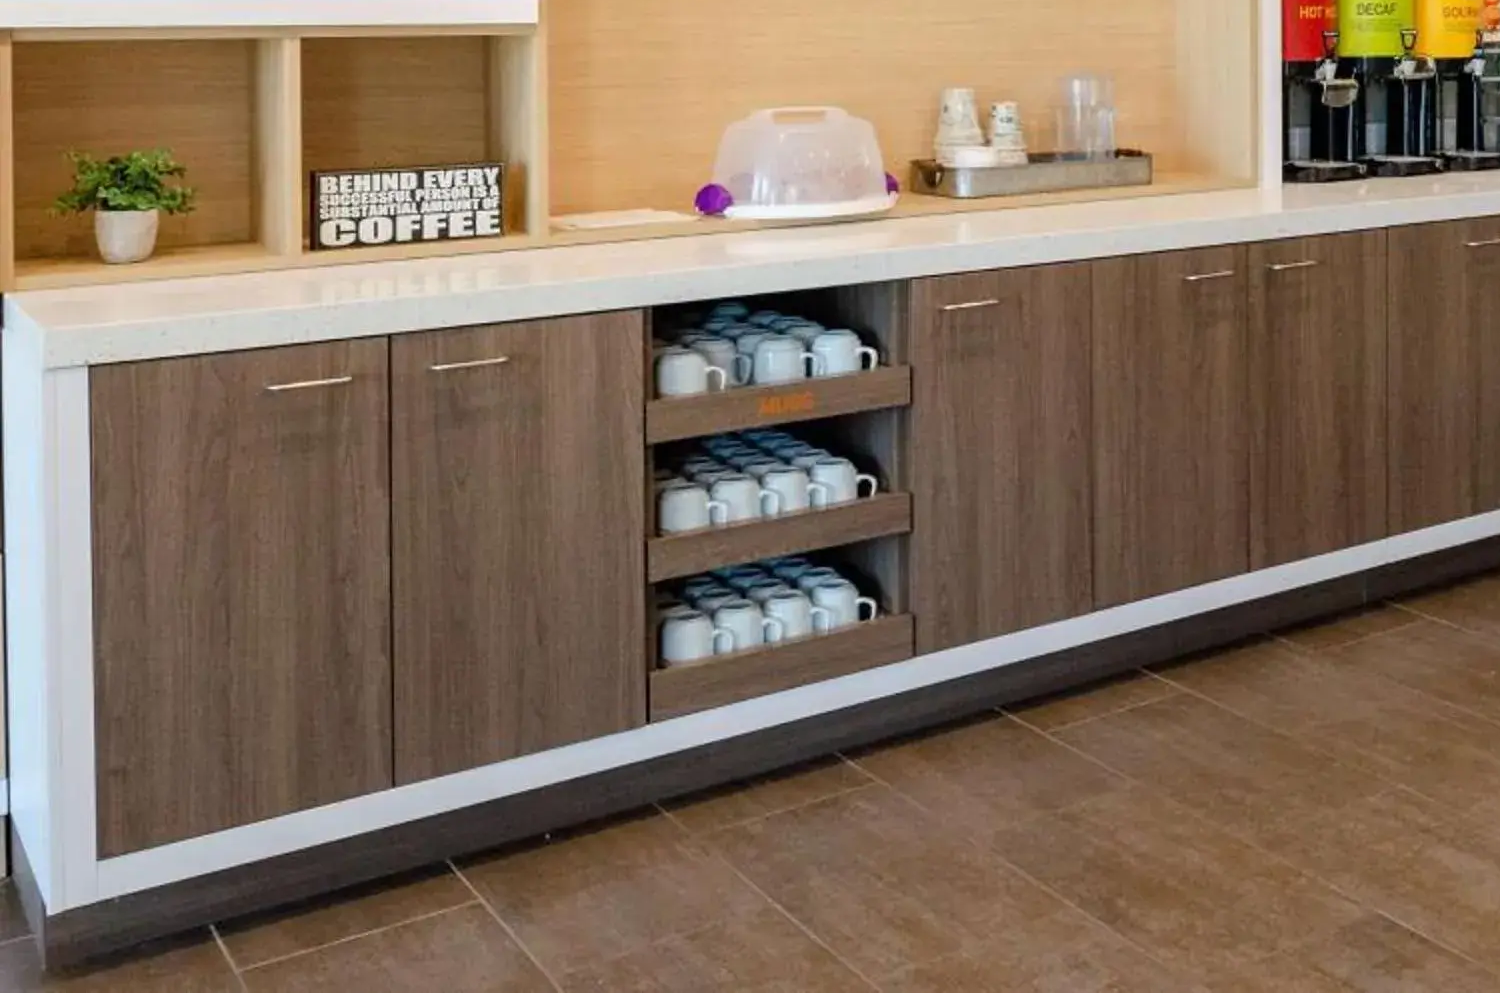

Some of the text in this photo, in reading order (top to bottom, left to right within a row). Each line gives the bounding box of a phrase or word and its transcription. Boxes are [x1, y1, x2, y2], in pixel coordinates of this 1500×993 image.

[1299, 5, 1322, 19] HOT
[1356, 2, 1398, 16] DECAF
[319, 167, 500, 194] BEHIND EVERY
[319, 185, 500, 207] SUCCESSFUL PERSON IS A
[319, 197, 500, 220] SUBSTANTIAL AMOUNT OF
[319, 209, 501, 247] COFFEE
